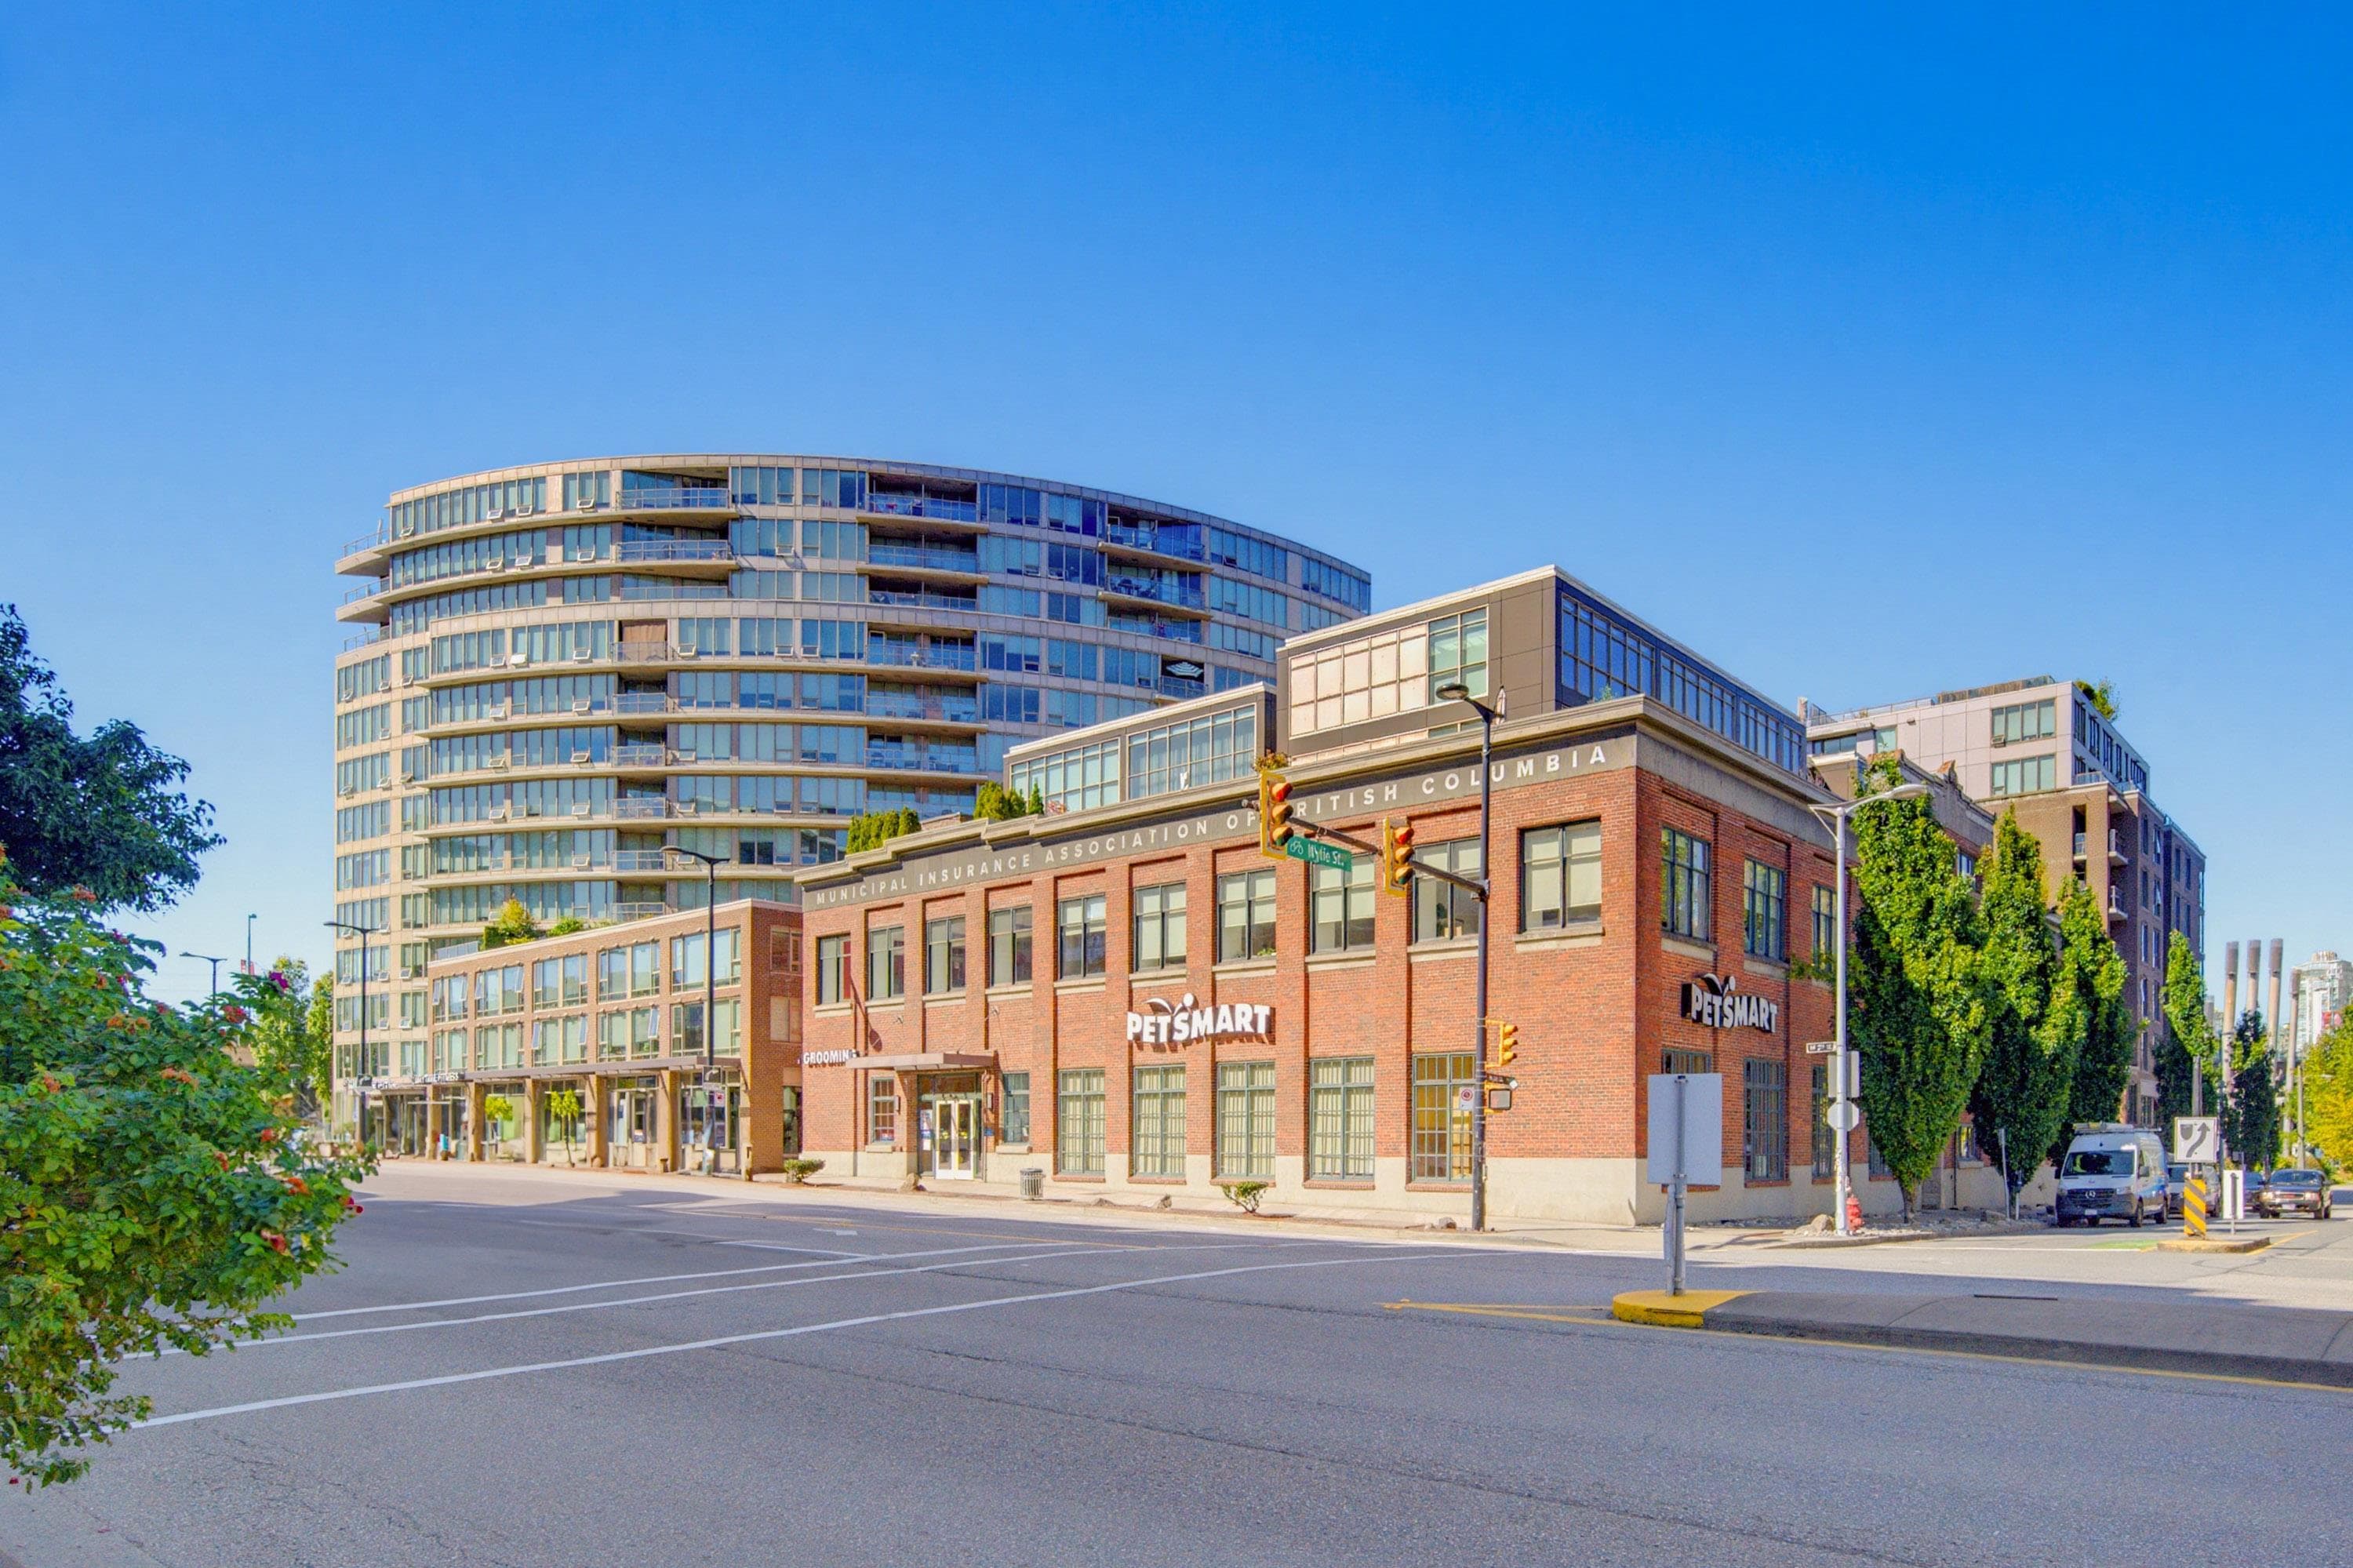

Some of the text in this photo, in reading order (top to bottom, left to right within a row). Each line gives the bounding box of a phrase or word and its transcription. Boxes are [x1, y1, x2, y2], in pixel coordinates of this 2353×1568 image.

[816, 878, 907, 904] MUNICIPAL
[919, 853, 1031, 886] INSURANCE
[1045, 820, 1207, 864] ASSOCIATION
[1296, 784, 1398, 817] RITISH
[1422, 745, 1606, 795] COLUMBIA
[1126, 1002, 1271, 1043] PETSMART
[1691, 982, 1778, 1033] PETSMART
